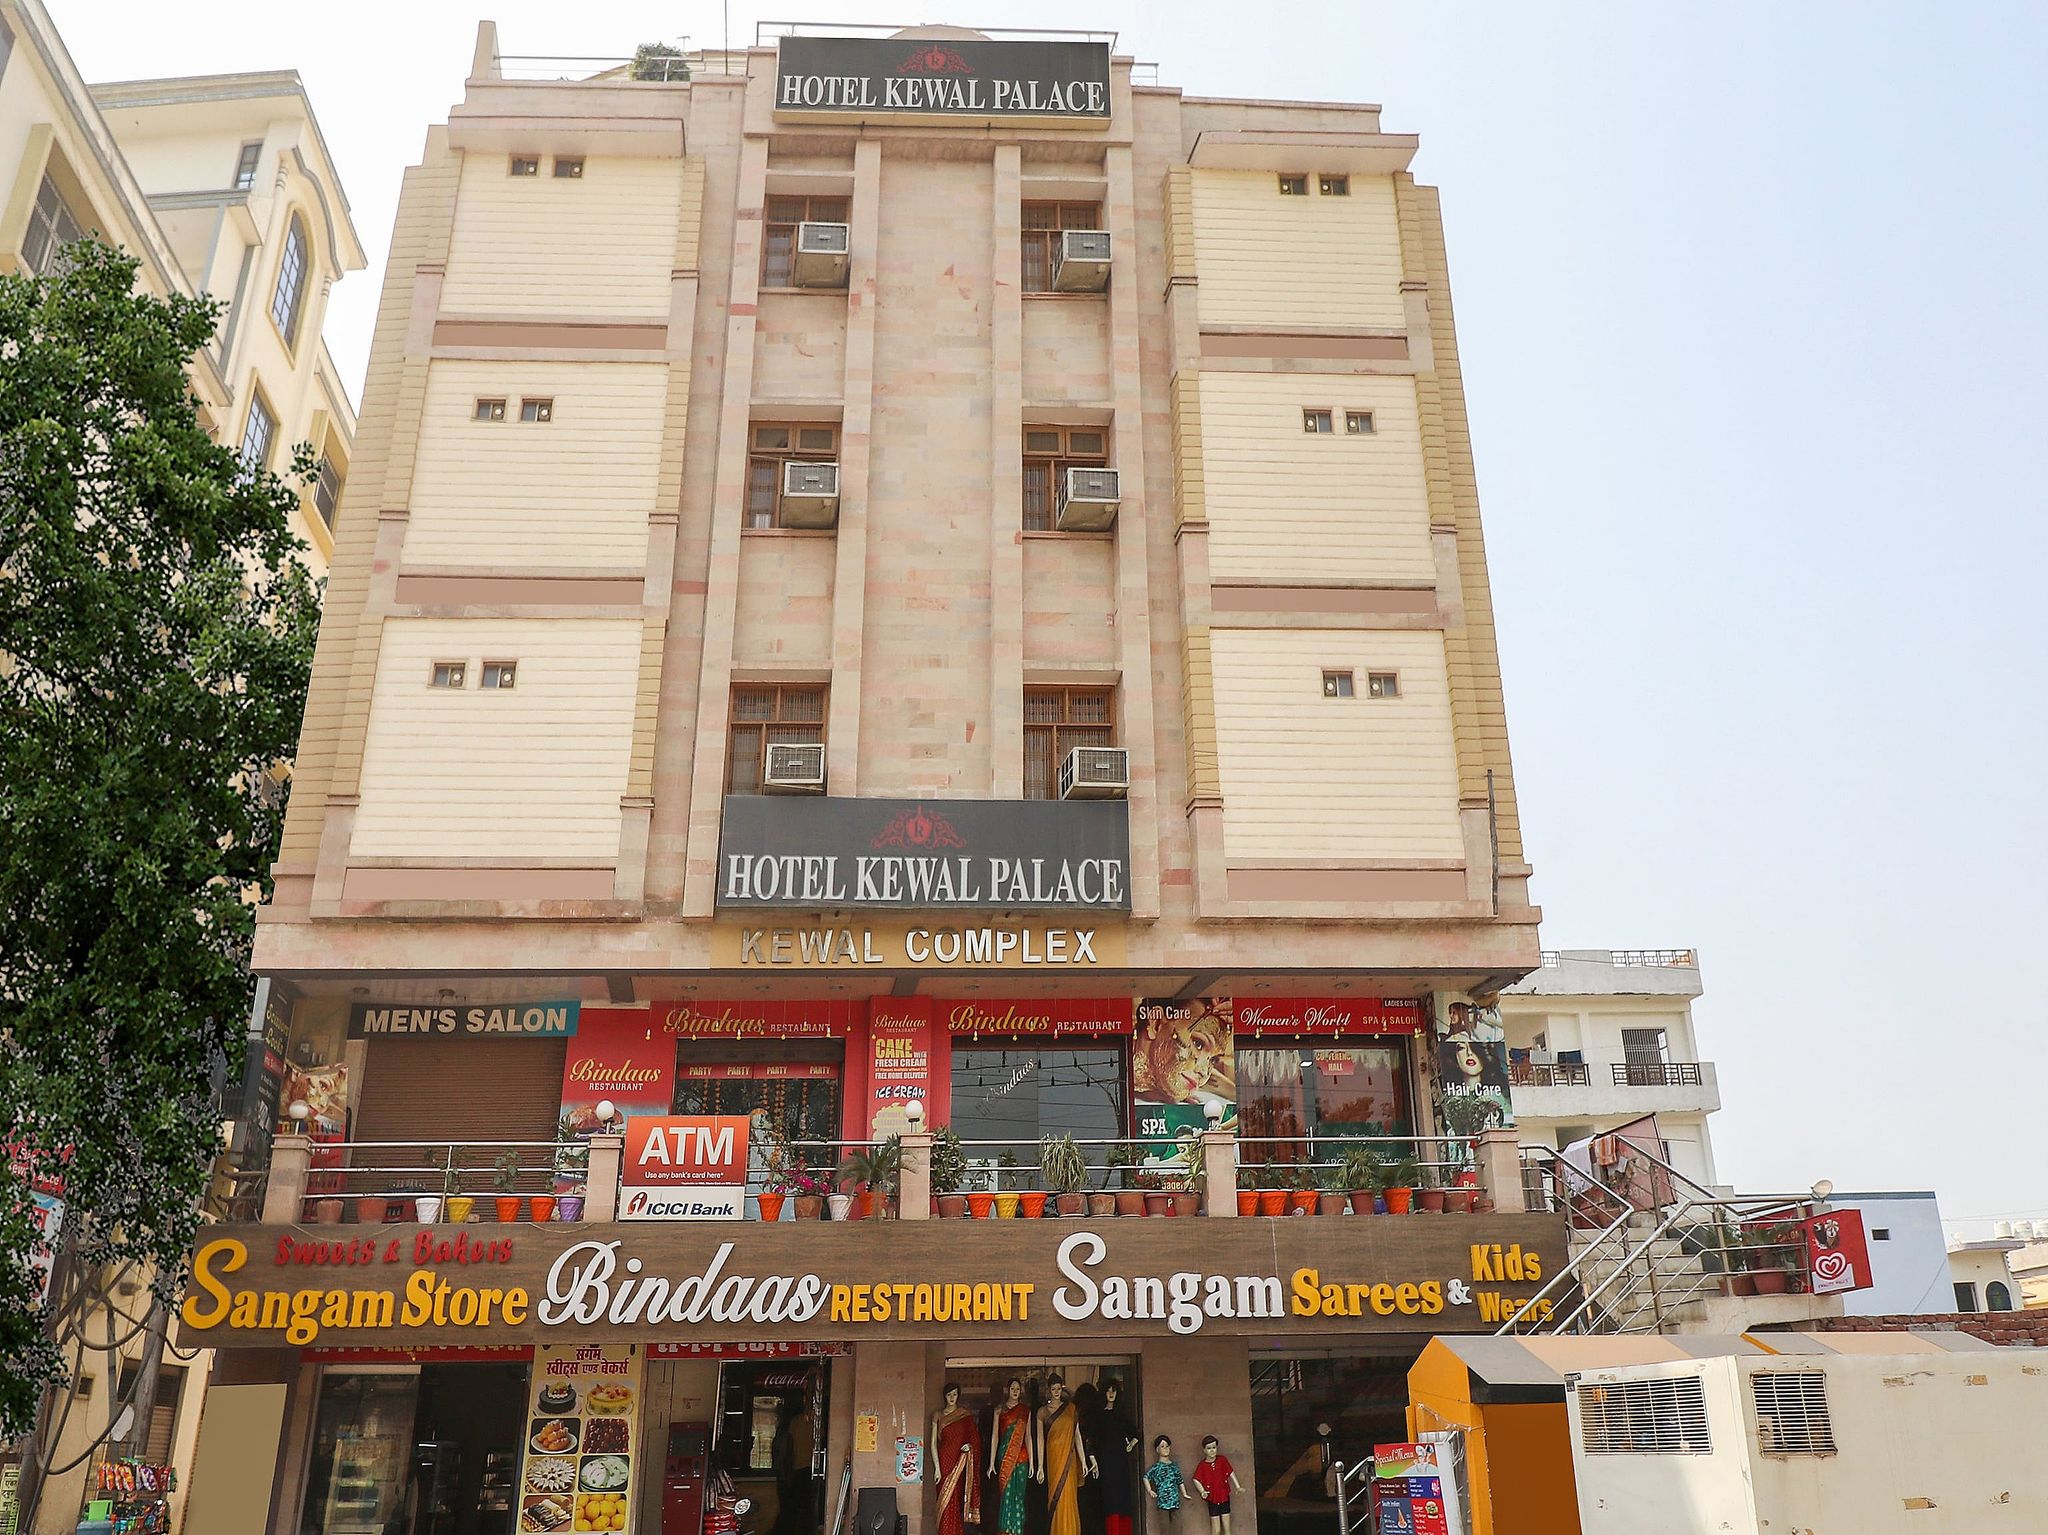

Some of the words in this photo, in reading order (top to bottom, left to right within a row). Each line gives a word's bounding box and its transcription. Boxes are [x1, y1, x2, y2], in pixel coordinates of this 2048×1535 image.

[781, 75, 877, 107] HOTEL
[883, 77, 986, 109] KEWAL
[993, 79, 1105, 112] PALACE
[725, 854, 846, 900] HOTEL
[854, 856, 981, 902] KEWAL
[988, 858, 1123, 903] PALACE
[741, 927, 884, 964] KEWAL
[905, 927, 1098, 964] COMPLEX
[363, 1009, 457, 1033] MEN'S
[466, 1007, 567, 1032] SALON
[663, 1007, 766, 1033] Bindaas
[770, 1023, 831, 1032] RESTAURANT
[874, 1014, 927, 1028] Bindaas
[948, 1003, 1050, 1032] Bindaas
[1057, 1021, 1122, 1031] RESTAURANT
[1139, 1006, 1164, 1020] Skin
[1165, 1007, 1191, 1020] Care
[1240, 1005, 1300, 1026] Women's
[1304, 1005, 1352, 1026] World
[1362, 1016, 1379, 1025] SPA
[1389, 1016, 1417, 1025] SALON
[875, 1039, 913, 1058] CAKE
[569, 1057, 661, 1082] Bindaas
[689, 1066, 713, 1076] PARTY
[727, 1066, 750, 1076] PARTY
[766, 1066, 788, 1075] PARTY
[809, 1065, 831, 1075] PARTY
[875, 1059, 898, 1067] FRESH
[900, 1059, 927, 1067] CREAM
[1328, 1063, 1343, 1072] HALL
[904, 1071, 928, 1079] DELIVERY
[589, 1083, 643, 1091] RESTAURANT
[875, 1086, 892, 1099] ICE
[893, 1085, 926, 1098] CREAM
[1446, 1082, 1471, 1096] Hair
[1475, 1082, 1502, 1096] Care
[1141, 1118, 1168, 1135] SPA
[638, 1126, 734, 1165] ATM
[671, 1171, 691, 1179] bank's
[691, 1171, 706, 1179] card
[646, 1203, 688, 1215] ICICI
[690, 1203, 734, 1216] Bank
[275, 1234, 376, 1265] Sweets
[383, 1241, 400, 1263] &
[413, 1230, 514, 1266] Bakers
[1471, 1244, 1542, 1282] Kids
[182, 1238, 395, 1345] Sangam
[401, 1269, 529, 1327] Store
[537, 1240, 832, 1326] Bindaas
[831, 1283, 1035, 1322] RESTAURANT
[1052, 1231, 1286, 1335] Sangam
[1291, 1268, 1442, 1316] Sarees
[1447, 1278, 1473, 1305] &
[1476, 1291, 1555, 1324] Wears
[576, 1346, 602, 1361] संगम
[600, 1358, 630, 1375] बेकर्स
[1375, 1449, 1395, 1468] Special
